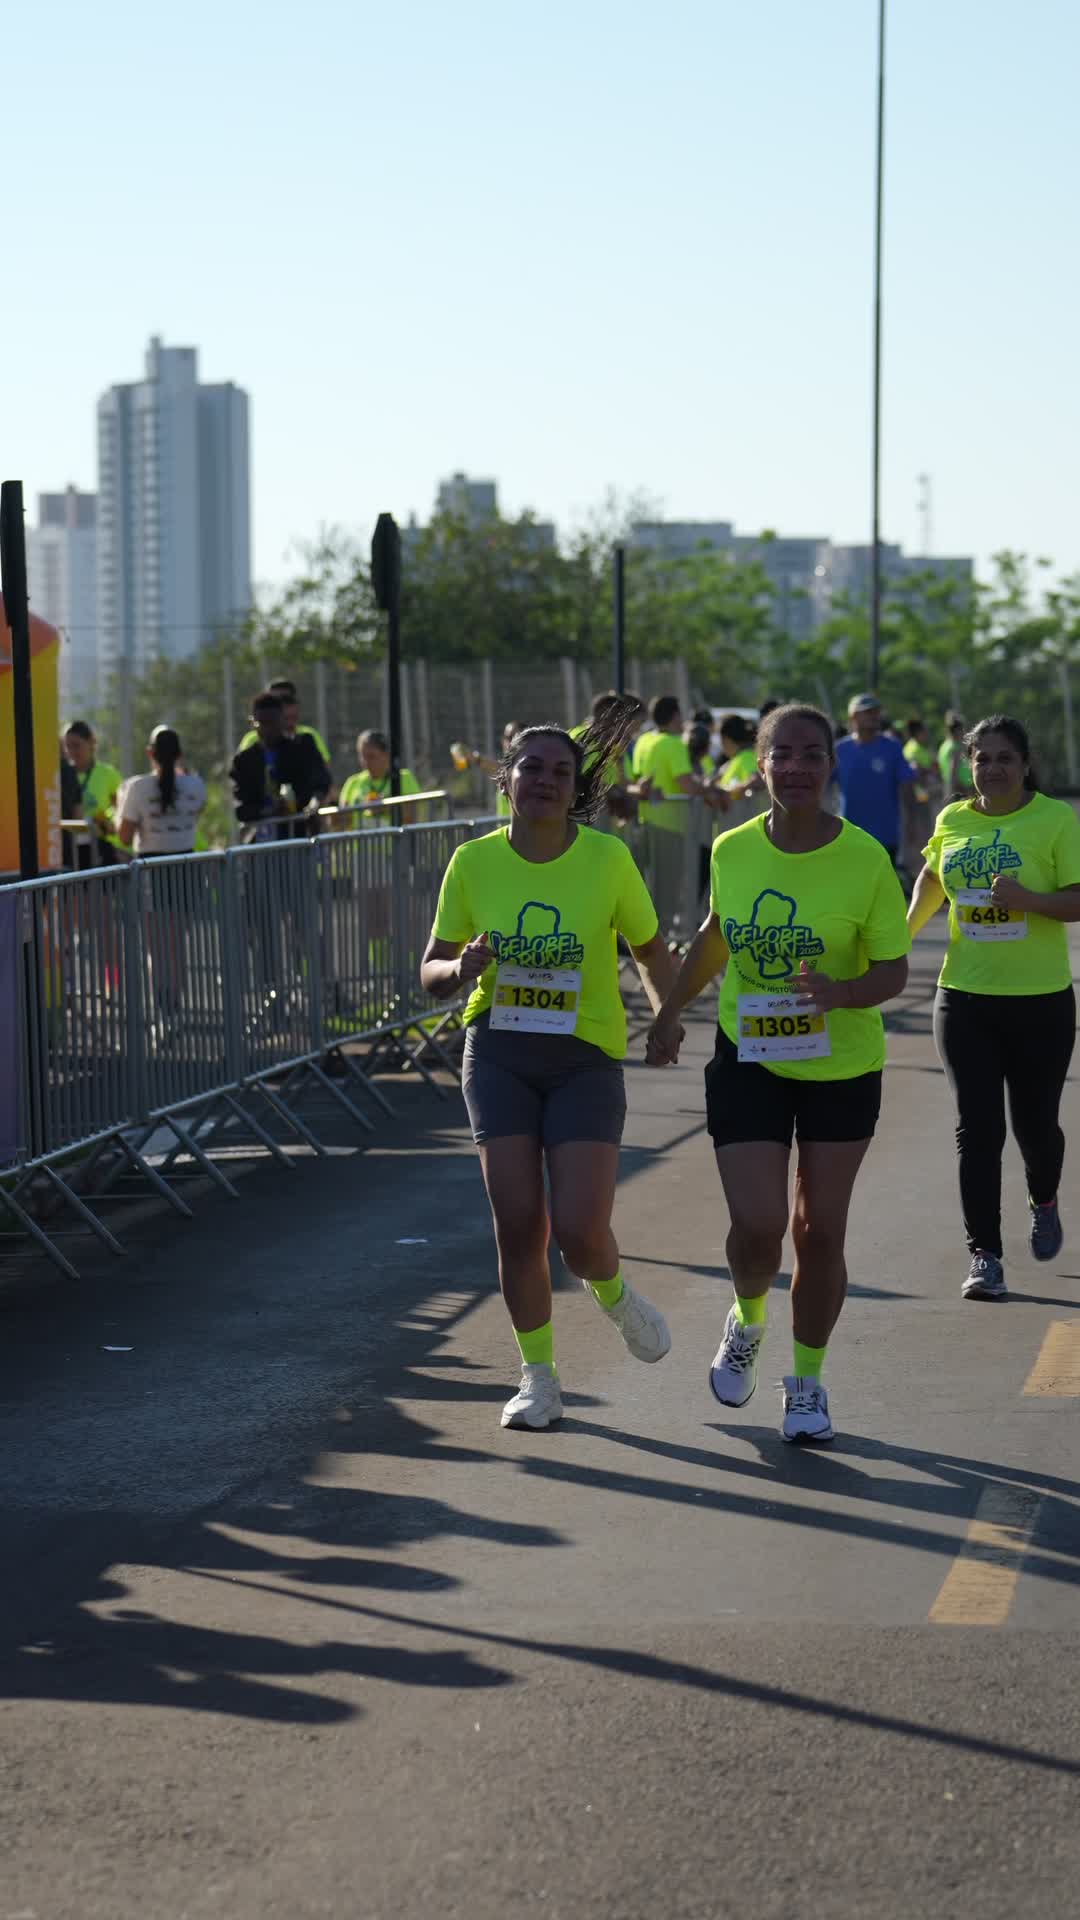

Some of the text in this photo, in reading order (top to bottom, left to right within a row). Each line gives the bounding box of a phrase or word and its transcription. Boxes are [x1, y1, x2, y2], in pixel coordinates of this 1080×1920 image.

[971, 906, 1009, 924] 648
[499, 935, 584, 960] GELOBEL
[730, 926, 821, 950] GELOBEL
[518, 951, 562, 970] RUN
[564, 952, 583, 962] 2026
[752, 943, 799, 962] RUN
[799, 946, 822, 956] 2026
[512, 987, 565, 1010] 1304
[755, 1014, 811, 1037] 1305
